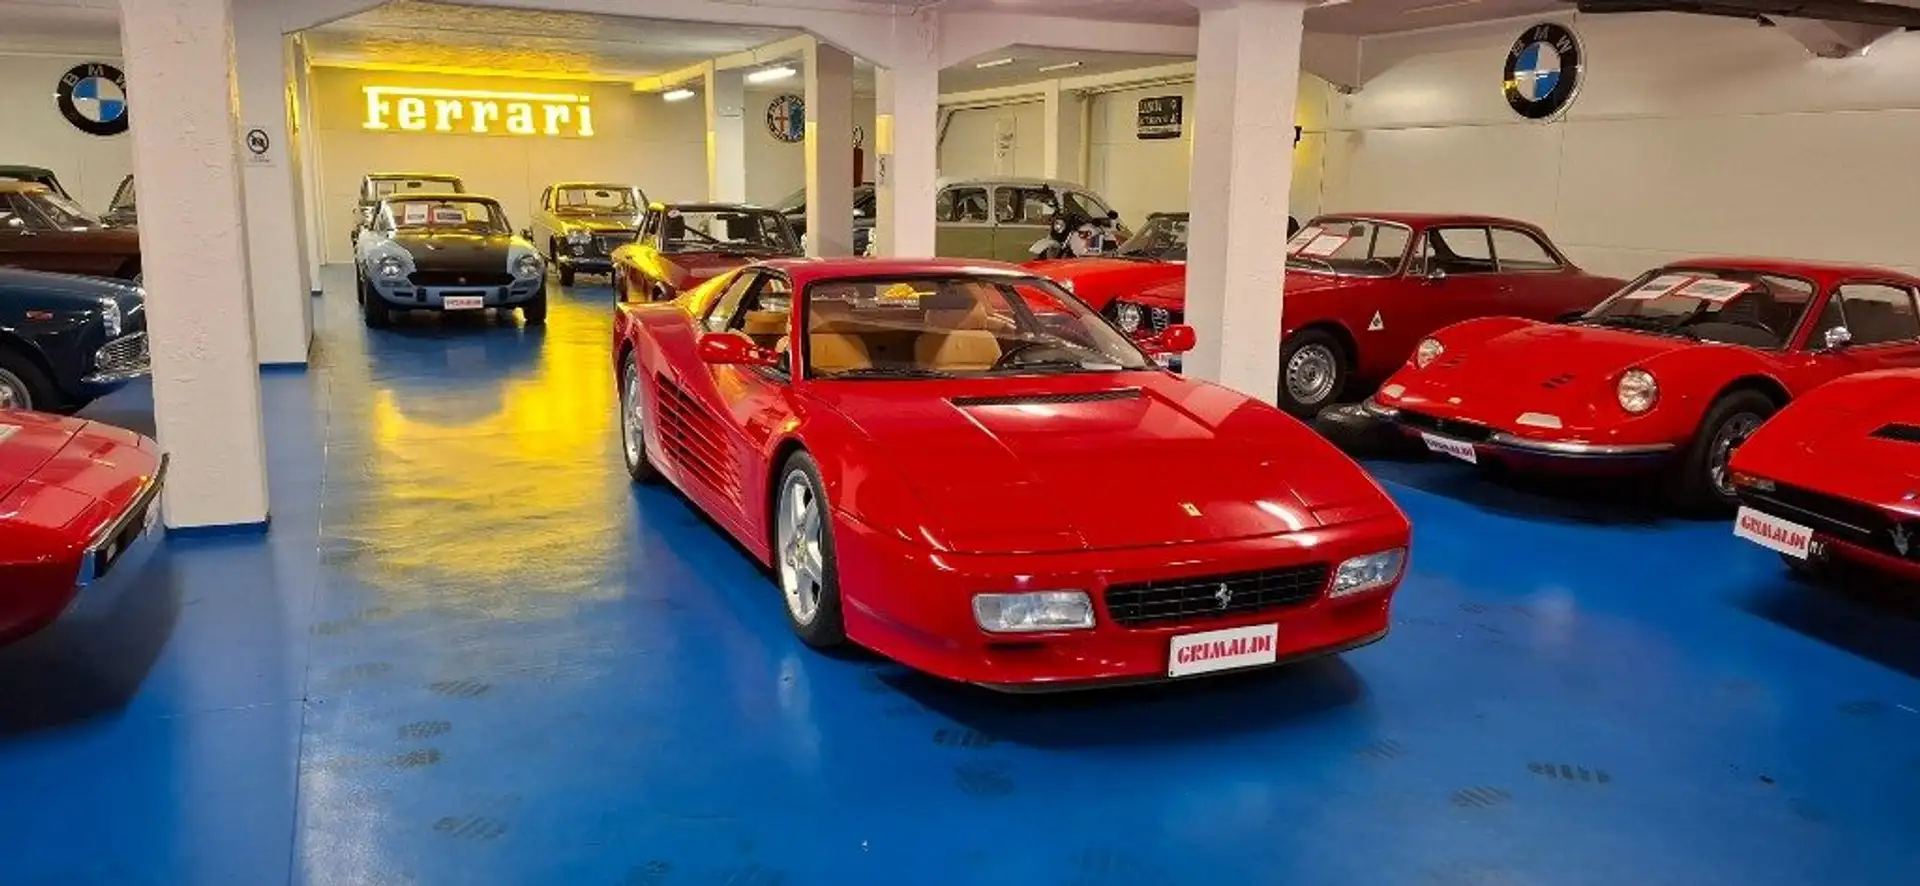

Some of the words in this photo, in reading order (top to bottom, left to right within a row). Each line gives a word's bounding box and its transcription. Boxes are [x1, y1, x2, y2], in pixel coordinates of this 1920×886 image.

[1511, 26, 1573, 55] BMW
[362, 86, 594, 136] Ferrari
[1741, 515, 1806, 550] GRIMALDI
[1177, 635, 1272, 664] GRIMALDI
